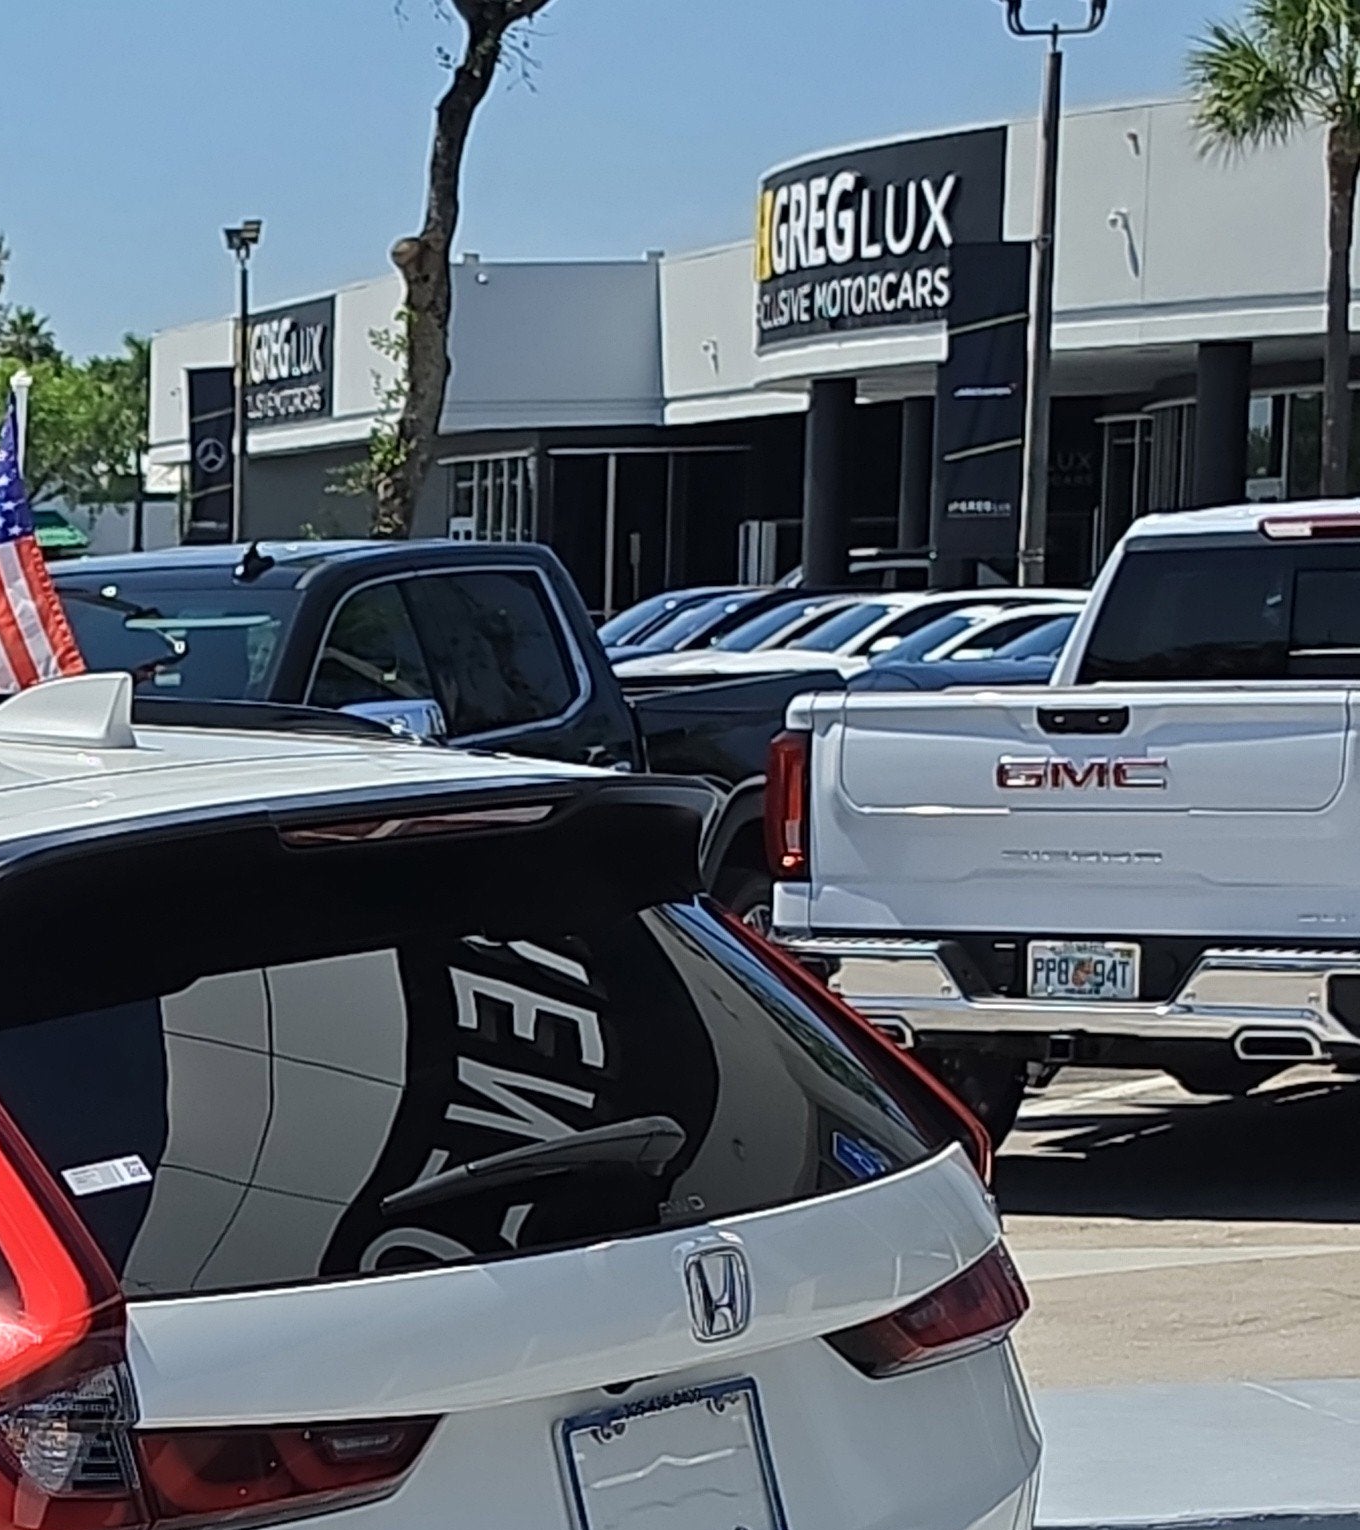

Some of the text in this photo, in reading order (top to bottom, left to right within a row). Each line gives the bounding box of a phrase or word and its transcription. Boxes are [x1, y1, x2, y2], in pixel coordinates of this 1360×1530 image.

[860, 174, 955, 259] LUX
[814, 266, 949, 319] MOTORCARS
[996, 755, 1168, 789] GMC
